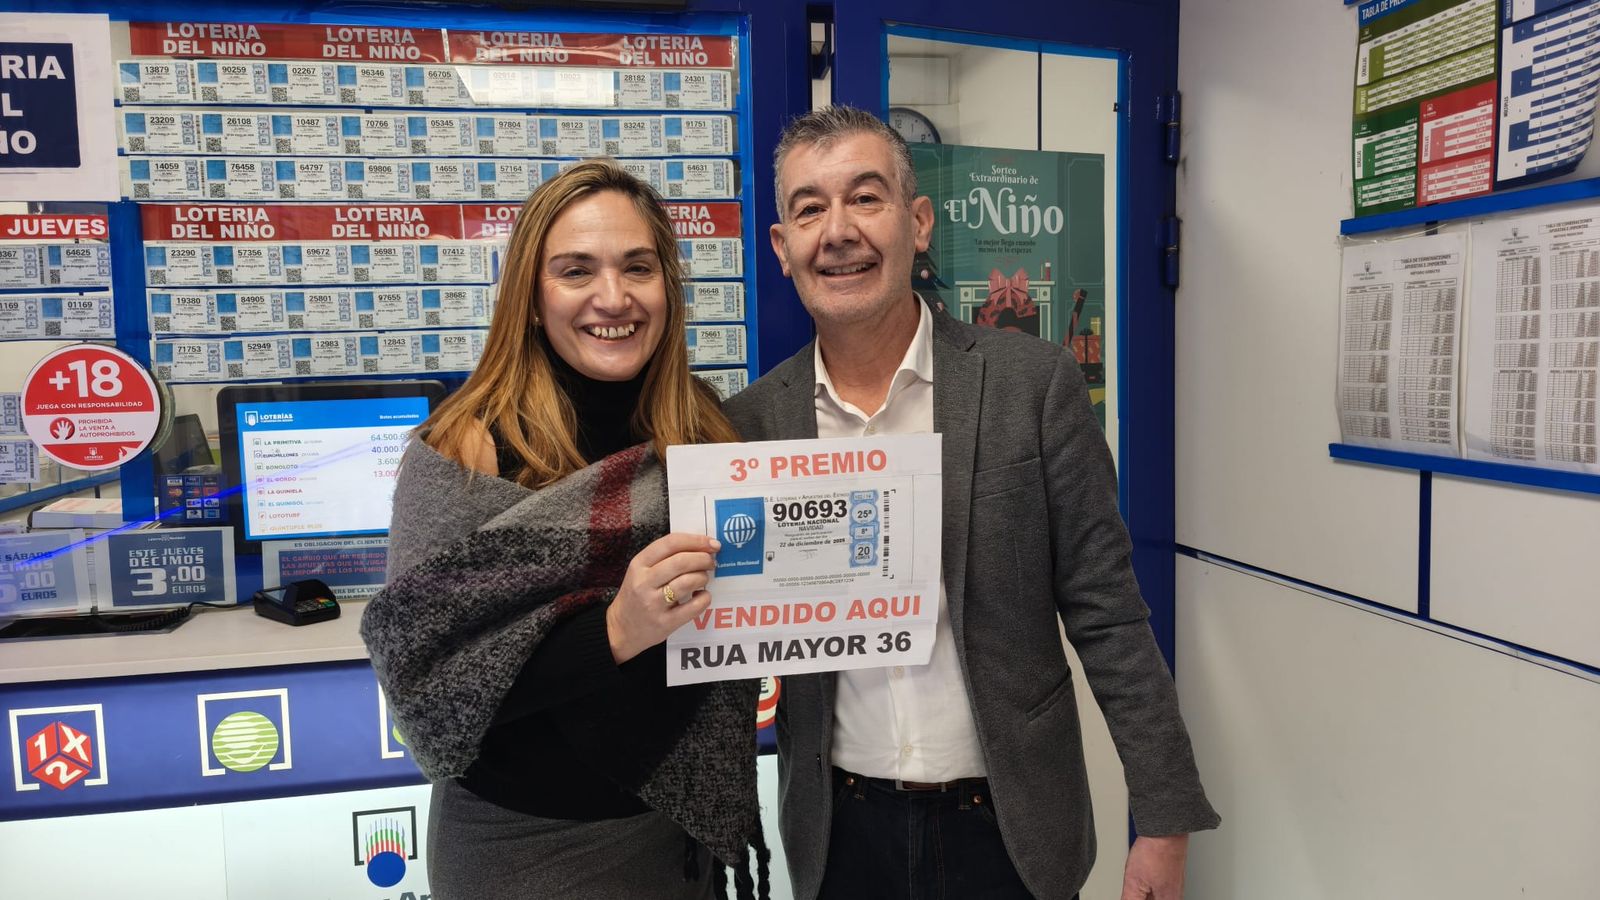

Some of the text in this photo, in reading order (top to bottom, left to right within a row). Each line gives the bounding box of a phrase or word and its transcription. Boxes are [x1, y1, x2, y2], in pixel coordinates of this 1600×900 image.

[1362, 4, 1380, 20] TABLA
[1380, 1, 1389, 12] DE
[166, 23, 260, 39] LOTERIA
[326, 27, 416, 44] LOTERIA
[480, 32, 564, 48] LOTERIA
[623, 36, 703, 50] LOTERIA
[163, 37, 266, 56] DEL NIÑO
[323, 42, 420, 60] DEL NIÑO
[476, 47, 569, 64] DEL NIÑO
[619, 49, 708, 65] DEL NIÑO
[361, 69, 384, 77] 96346
[428, 70, 452, 78] 66705
[296, 118, 320, 126] 10487
[365, 120, 389, 128] 70766
[431, 120, 454, 128] 05345
[231, 163, 255, 171] 76458
[300, 164, 323, 172] 64797
[368, 165, 392, 173] 69806
[435, 165, 457, 173] 14655
[500, 165, 522, 173] 57164
[687, 164, 707, 172] 64631
[991, 165, 1017, 175] Sorteo
[969, 172, 1039, 184] Extraordinario de
[175, 208, 269, 222] LOTERIA
[335, 207, 424, 222] LOTERIA
[943, 187, 1064, 238] El Niño
[7, 219, 105, 236] JUEVES
[171, 222, 275, 239] DEL NIÑO
[331, 223, 430, 238] DEL NIÑO
[171, 249, 196, 257] 23290
[176, 297, 201, 305] 19380
[241, 295, 265, 303] 84905
[177, 345, 201, 353] 71753
[49, 359, 123, 397] +18
[730, 449, 887, 482] 3º PREMIO
[772, 499, 848, 521] 90693
[857, 510, 872, 519] 25ª
[129, 546, 204, 558] ESTE JUEVES
[858, 546, 870, 555] 20
[129, 554, 204, 567] DÉCIMOS
[130, 565, 205, 597] 3,00
[172, 584, 206, 594] EUROS
[21, 590, 57, 601] EUROS
[691, 595, 921, 631] VENDIDO AQUI
[680, 630, 911, 671] RUA MAYOR 36
